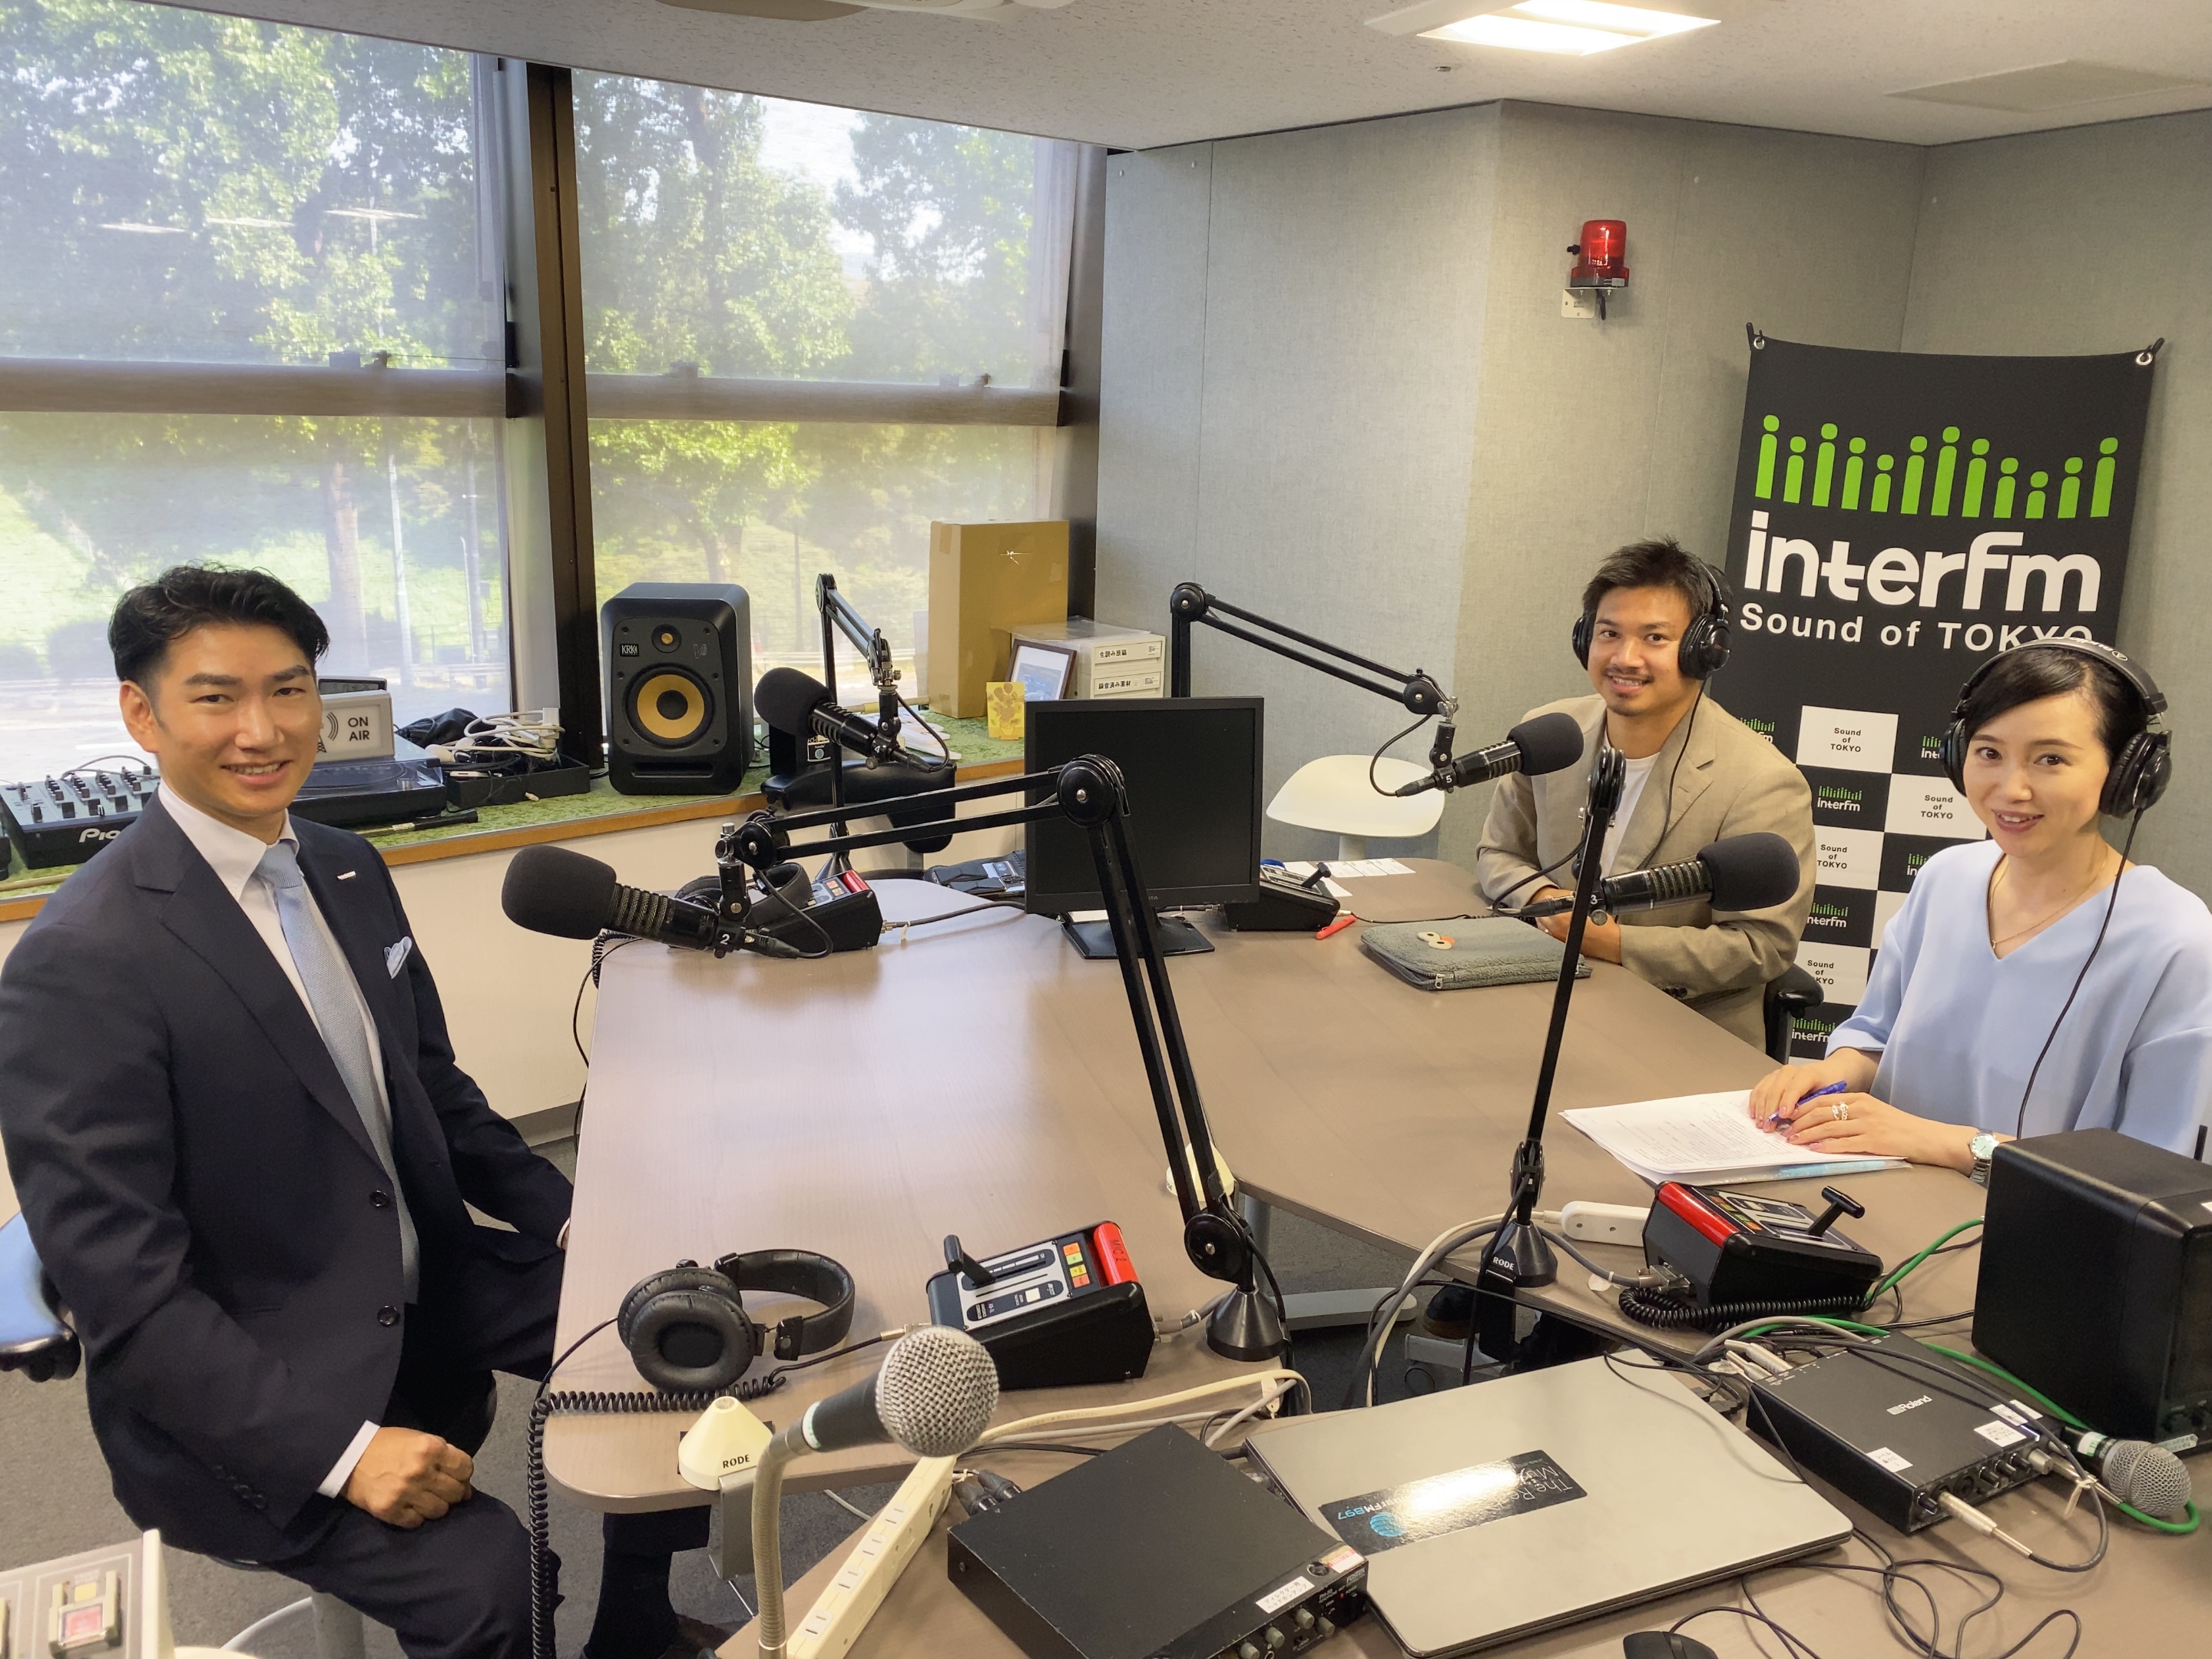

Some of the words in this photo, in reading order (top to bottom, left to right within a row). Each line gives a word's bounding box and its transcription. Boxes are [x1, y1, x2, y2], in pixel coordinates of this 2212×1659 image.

[1743, 510, 2101, 612] interfm
[1740, 602, 1863, 642] Sound
[1880, 621, 1920, 647] of
[621, 644, 636, 654] KRK
[348, 716, 369, 728] ON
[349, 730, 370, 742] AIR
[1834, 727, 1862, 736] Sound
[1830, 743, 1862, 753] TOKYO
[1445, 775, 1452, 783] 5
[1925, 794, 1954, 803] Sound
[1817, 797, 1861, 812] interfm
[1920, 811, 1953, 820] TOKYO
[78, 828, 121, 843] Pio
[1820, 844, 1848, 853] Sound
[1816, 860, 1847, 869] TOKYO
[1590, 895, 1598, 905] 3
[1806, 916, 1847, 928] nterfm
[720, 933, 730, 945] 2
[1807, 959, 1834, 969] Sound
[1898, 1395, 1933, 1411] Roland
[1534, 1479, 1574, 1492] The
